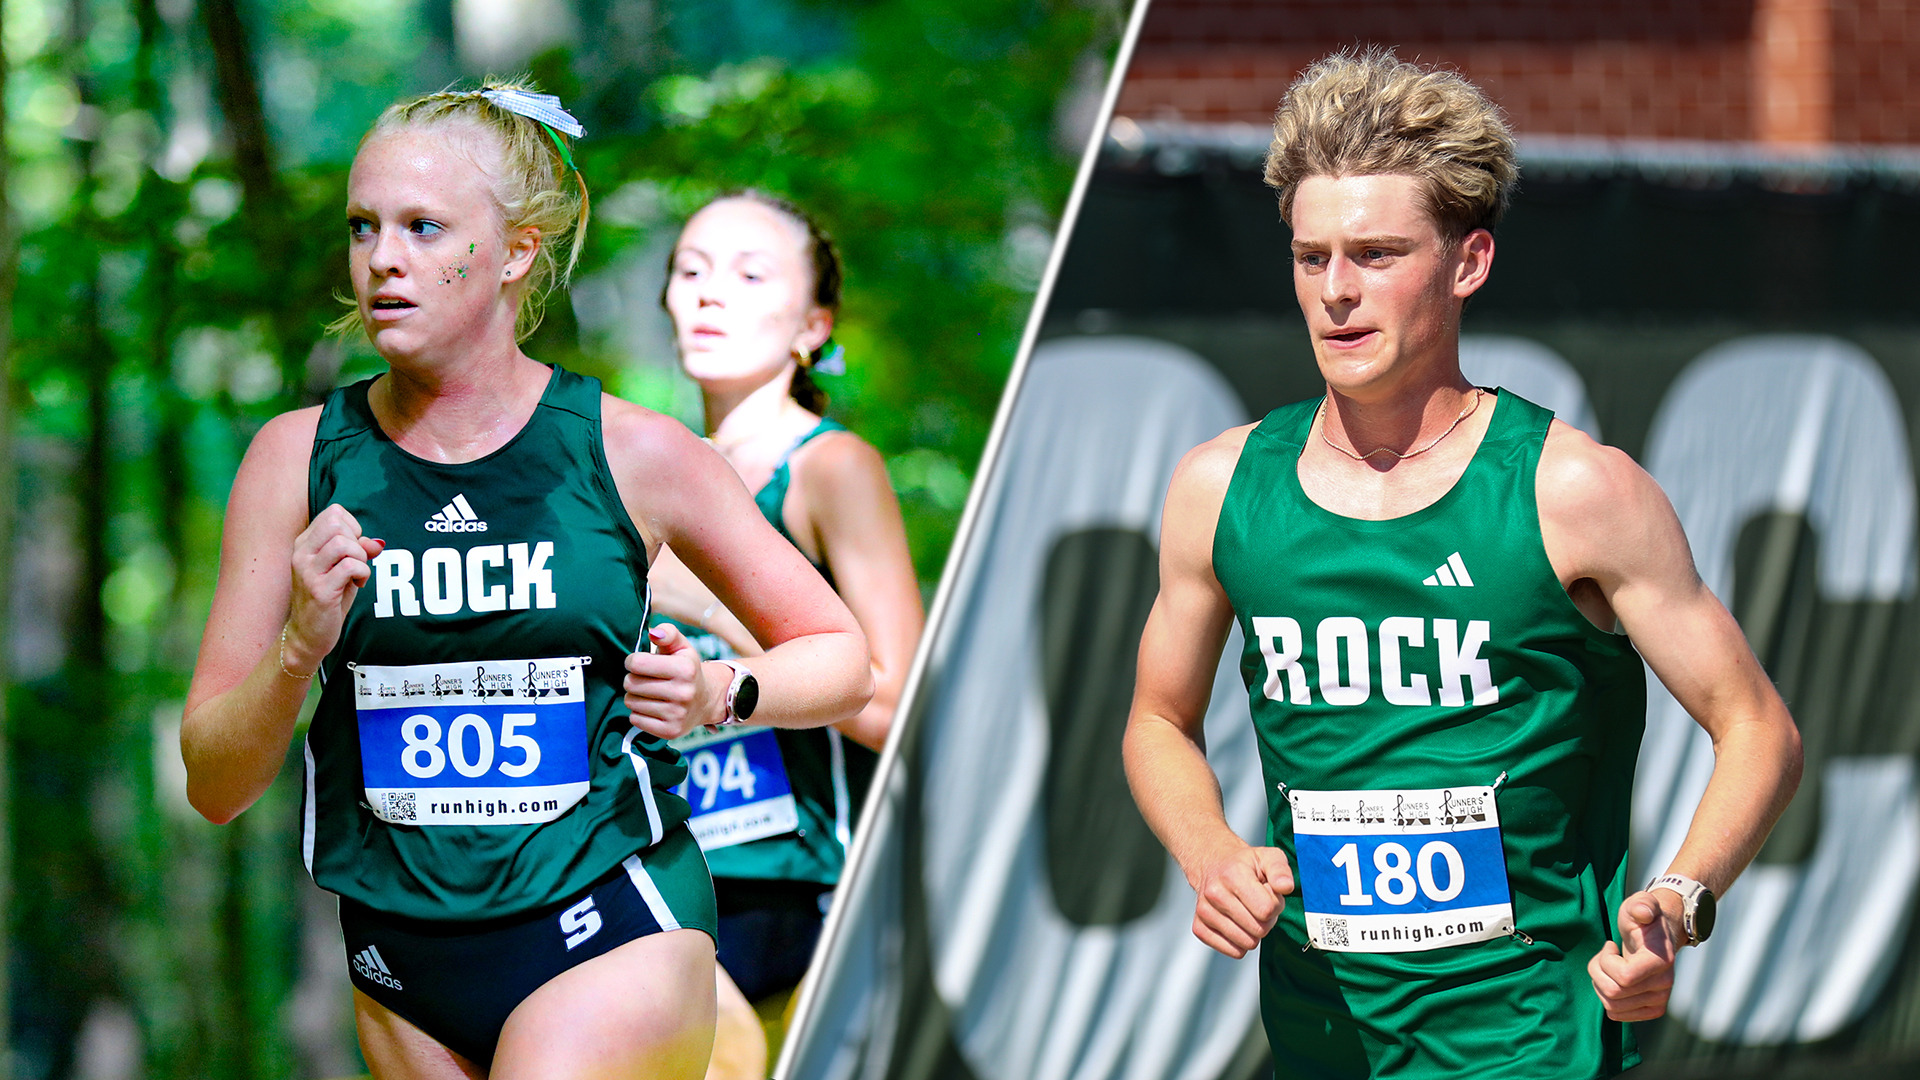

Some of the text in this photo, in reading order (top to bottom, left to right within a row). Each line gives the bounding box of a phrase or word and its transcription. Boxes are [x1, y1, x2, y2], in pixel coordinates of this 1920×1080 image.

[424, 519, 488, 533] adidas
[372, 541, 557, 618] ROCK
[1252, 616, 1500, 707] ROCK
[543, 680, 567, 689] HIGH
[400, 713, 541, 779] 805
[430, 797, 558, 817] runhigh.com
[1459, 806, 1484, 815] HIGH
[1331, 840, 1465, 906] 180
[558, 893, 603, 952] S
[1361, 919, 1485, 942] runhigh.com
[353, 958, 404, 992] adidas
